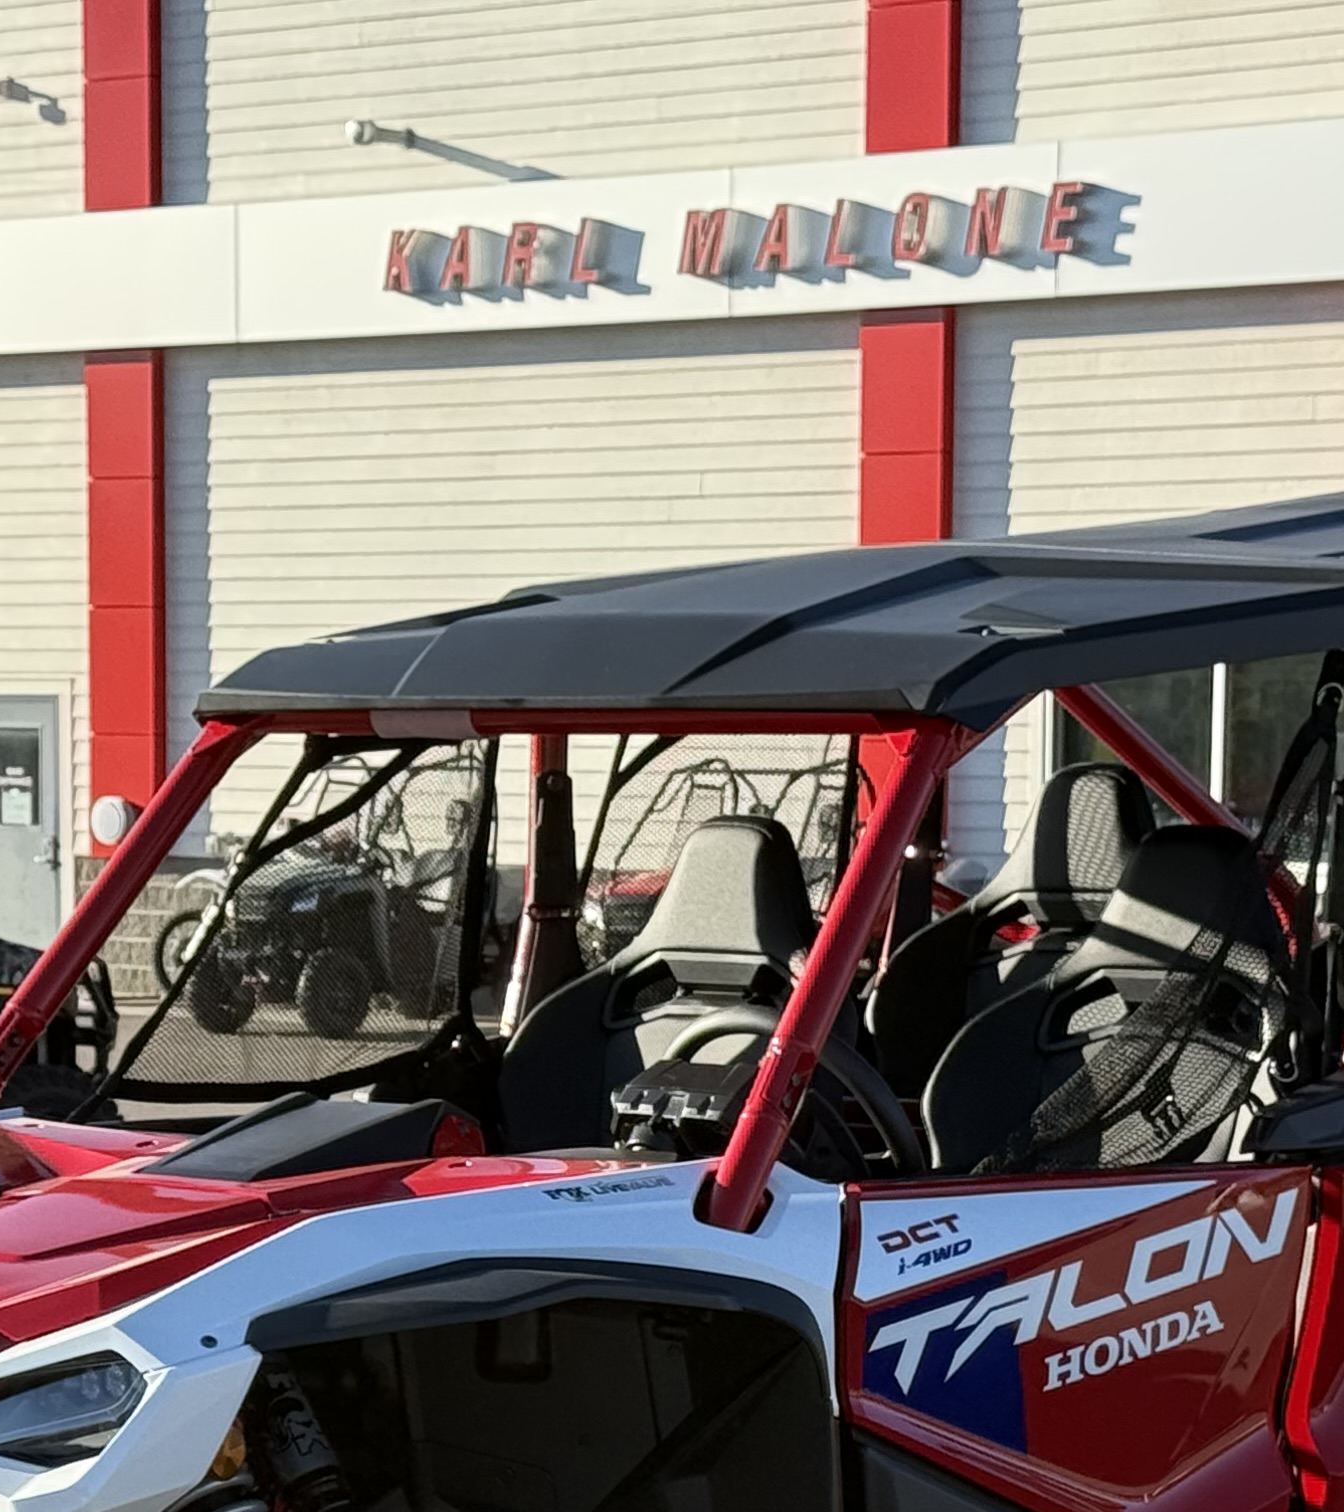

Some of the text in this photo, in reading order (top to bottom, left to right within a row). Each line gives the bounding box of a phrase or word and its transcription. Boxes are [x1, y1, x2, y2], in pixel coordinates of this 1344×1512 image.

[382, 180, 1085, 292] KARL MALONE
[877, 1212, 960, 1255] DCT
[896, 1238, 973, 1277] i-4WD
[867, 1187, 1299, 1396] TALON
[1042, 1300, 1225, 1393] HONDA
